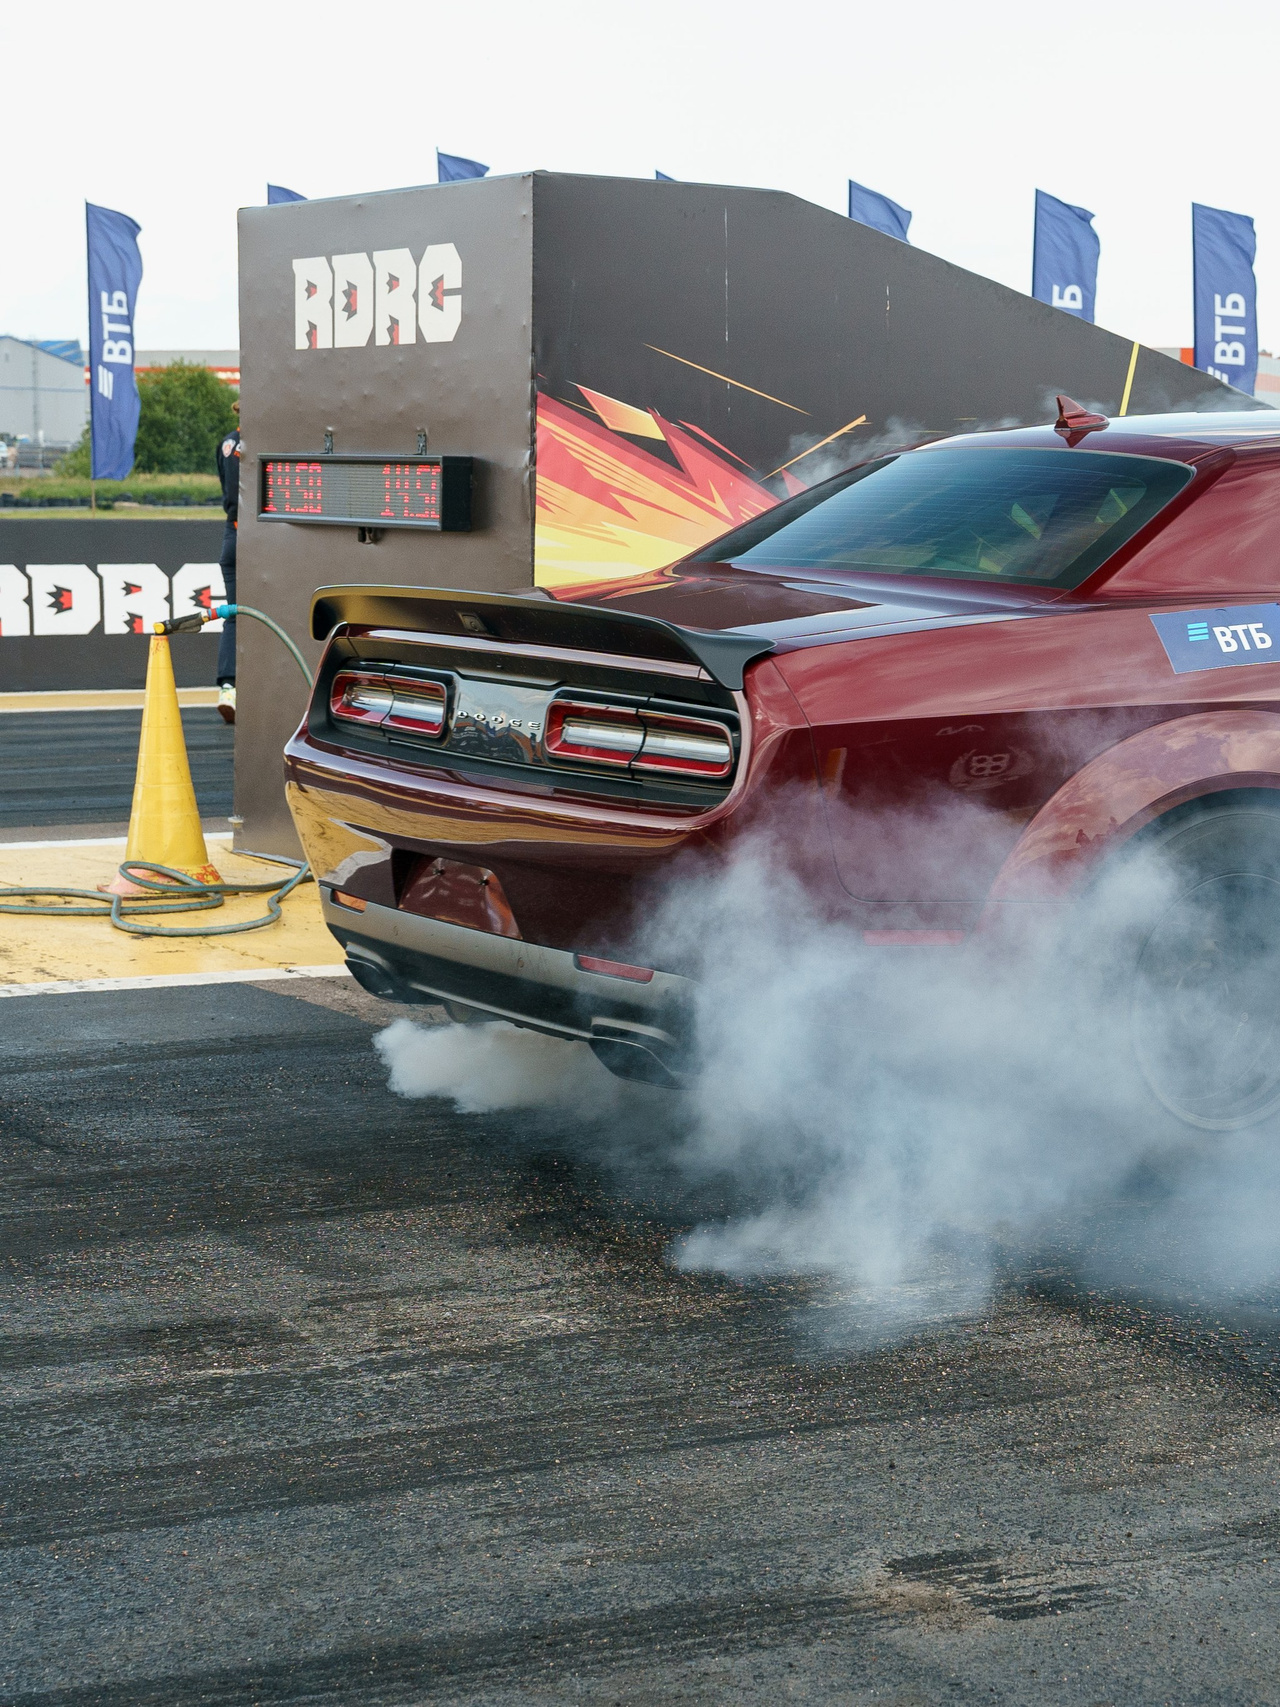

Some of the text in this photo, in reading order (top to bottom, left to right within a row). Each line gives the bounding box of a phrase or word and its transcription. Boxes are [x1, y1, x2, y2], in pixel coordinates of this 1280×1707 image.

[101, 290, 133, 365] ВТБ
[292, 242, 463, 350] RDRC
[1214, 292, 1247, 366] ВТБ
[1212, 623, 1273, 653] ВТБ
[457, 710, 541, 730] DODGE
